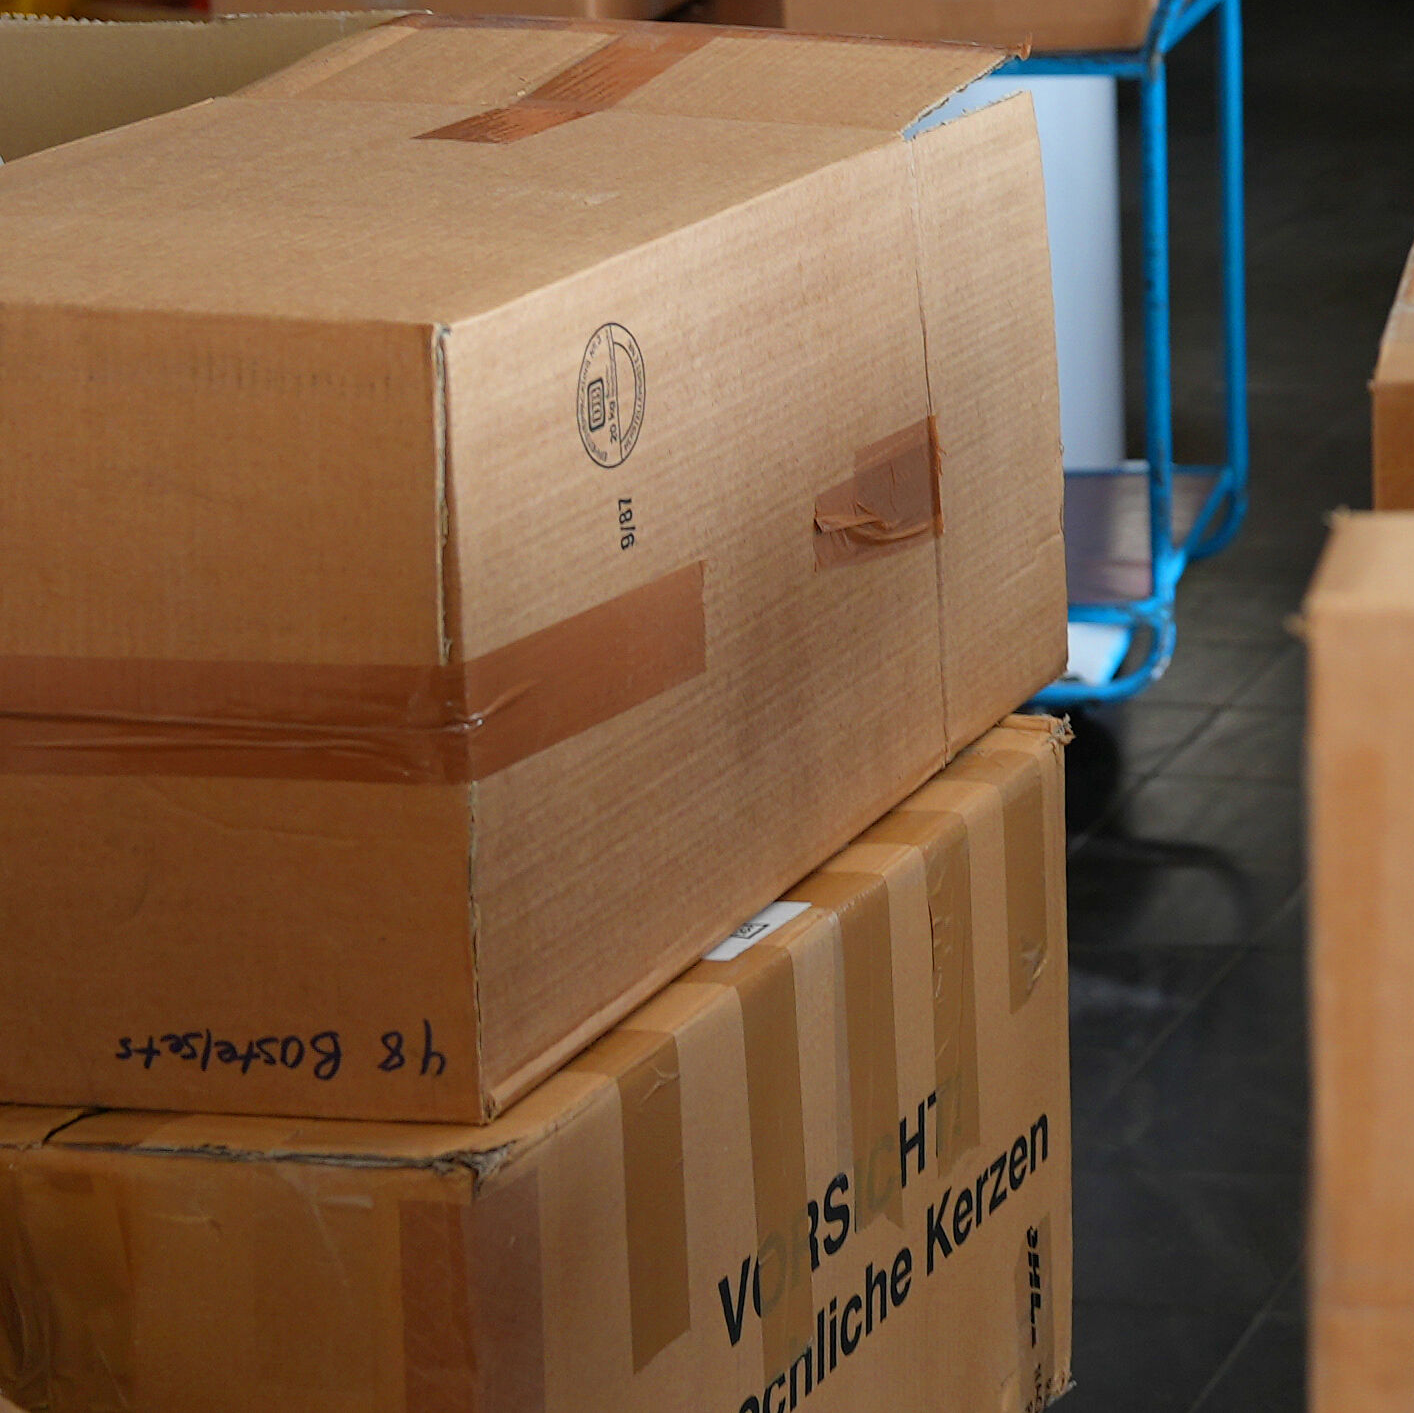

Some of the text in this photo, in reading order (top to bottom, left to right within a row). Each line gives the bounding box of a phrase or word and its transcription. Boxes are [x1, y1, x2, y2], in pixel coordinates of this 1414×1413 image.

[618, 497, 636, 550] 9/87
[378, 1018, 447, 1077] 48
[925, 1112, 1049, 1277] Kerzen
